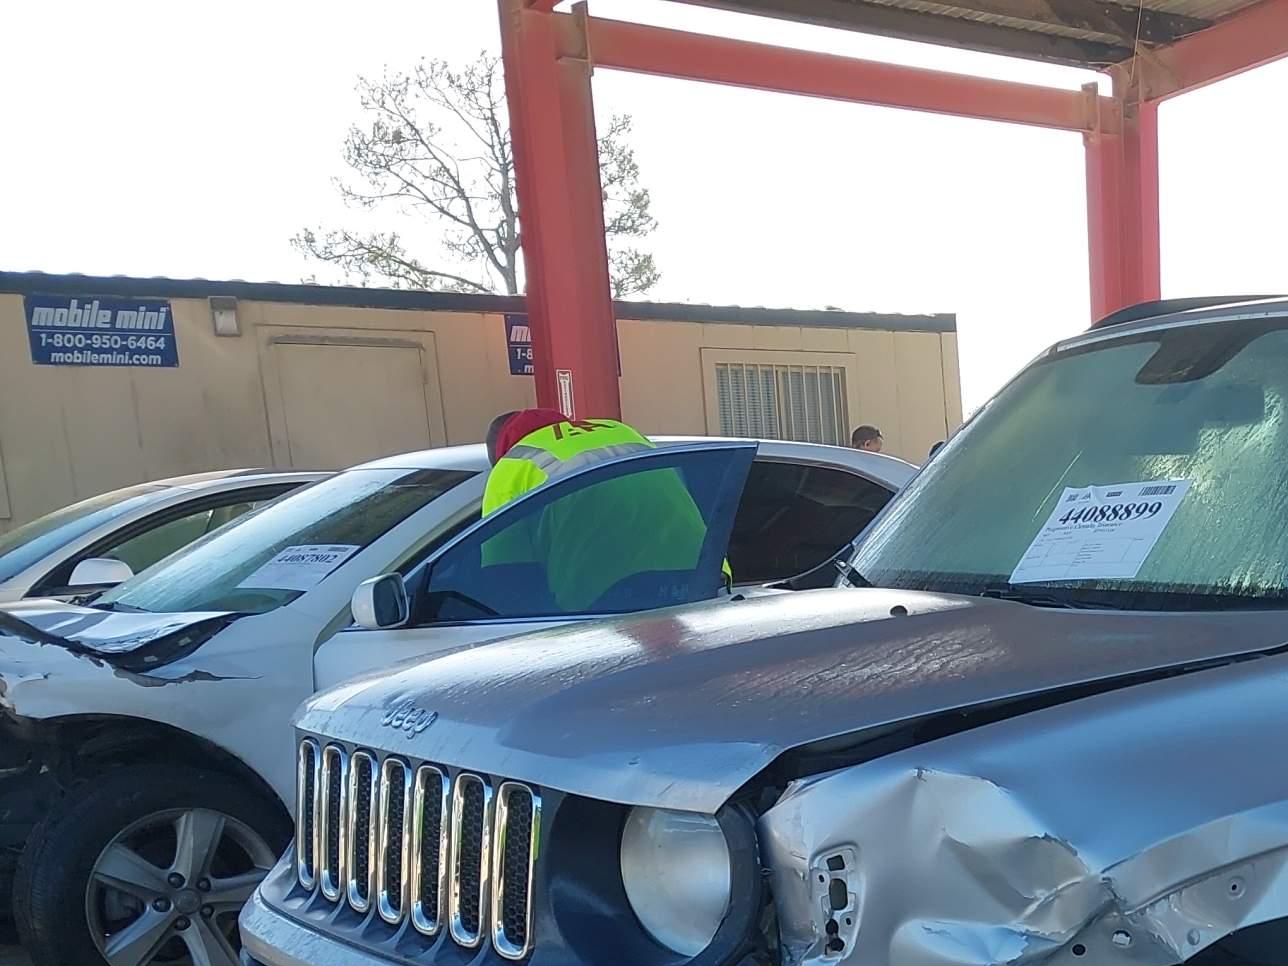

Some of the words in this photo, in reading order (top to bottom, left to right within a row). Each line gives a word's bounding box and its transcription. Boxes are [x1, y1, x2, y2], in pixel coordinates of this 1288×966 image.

[32, 299, 111, 328] mobile
[115, 306, 167, 330] mini
[40, 333, 166, 350] 1-800-950-6464
[50, 351, 162, 365] mobilemini.com
[1059, 501, 1163, 525] 44088899
[381, 699, 439, 739] Jeep
